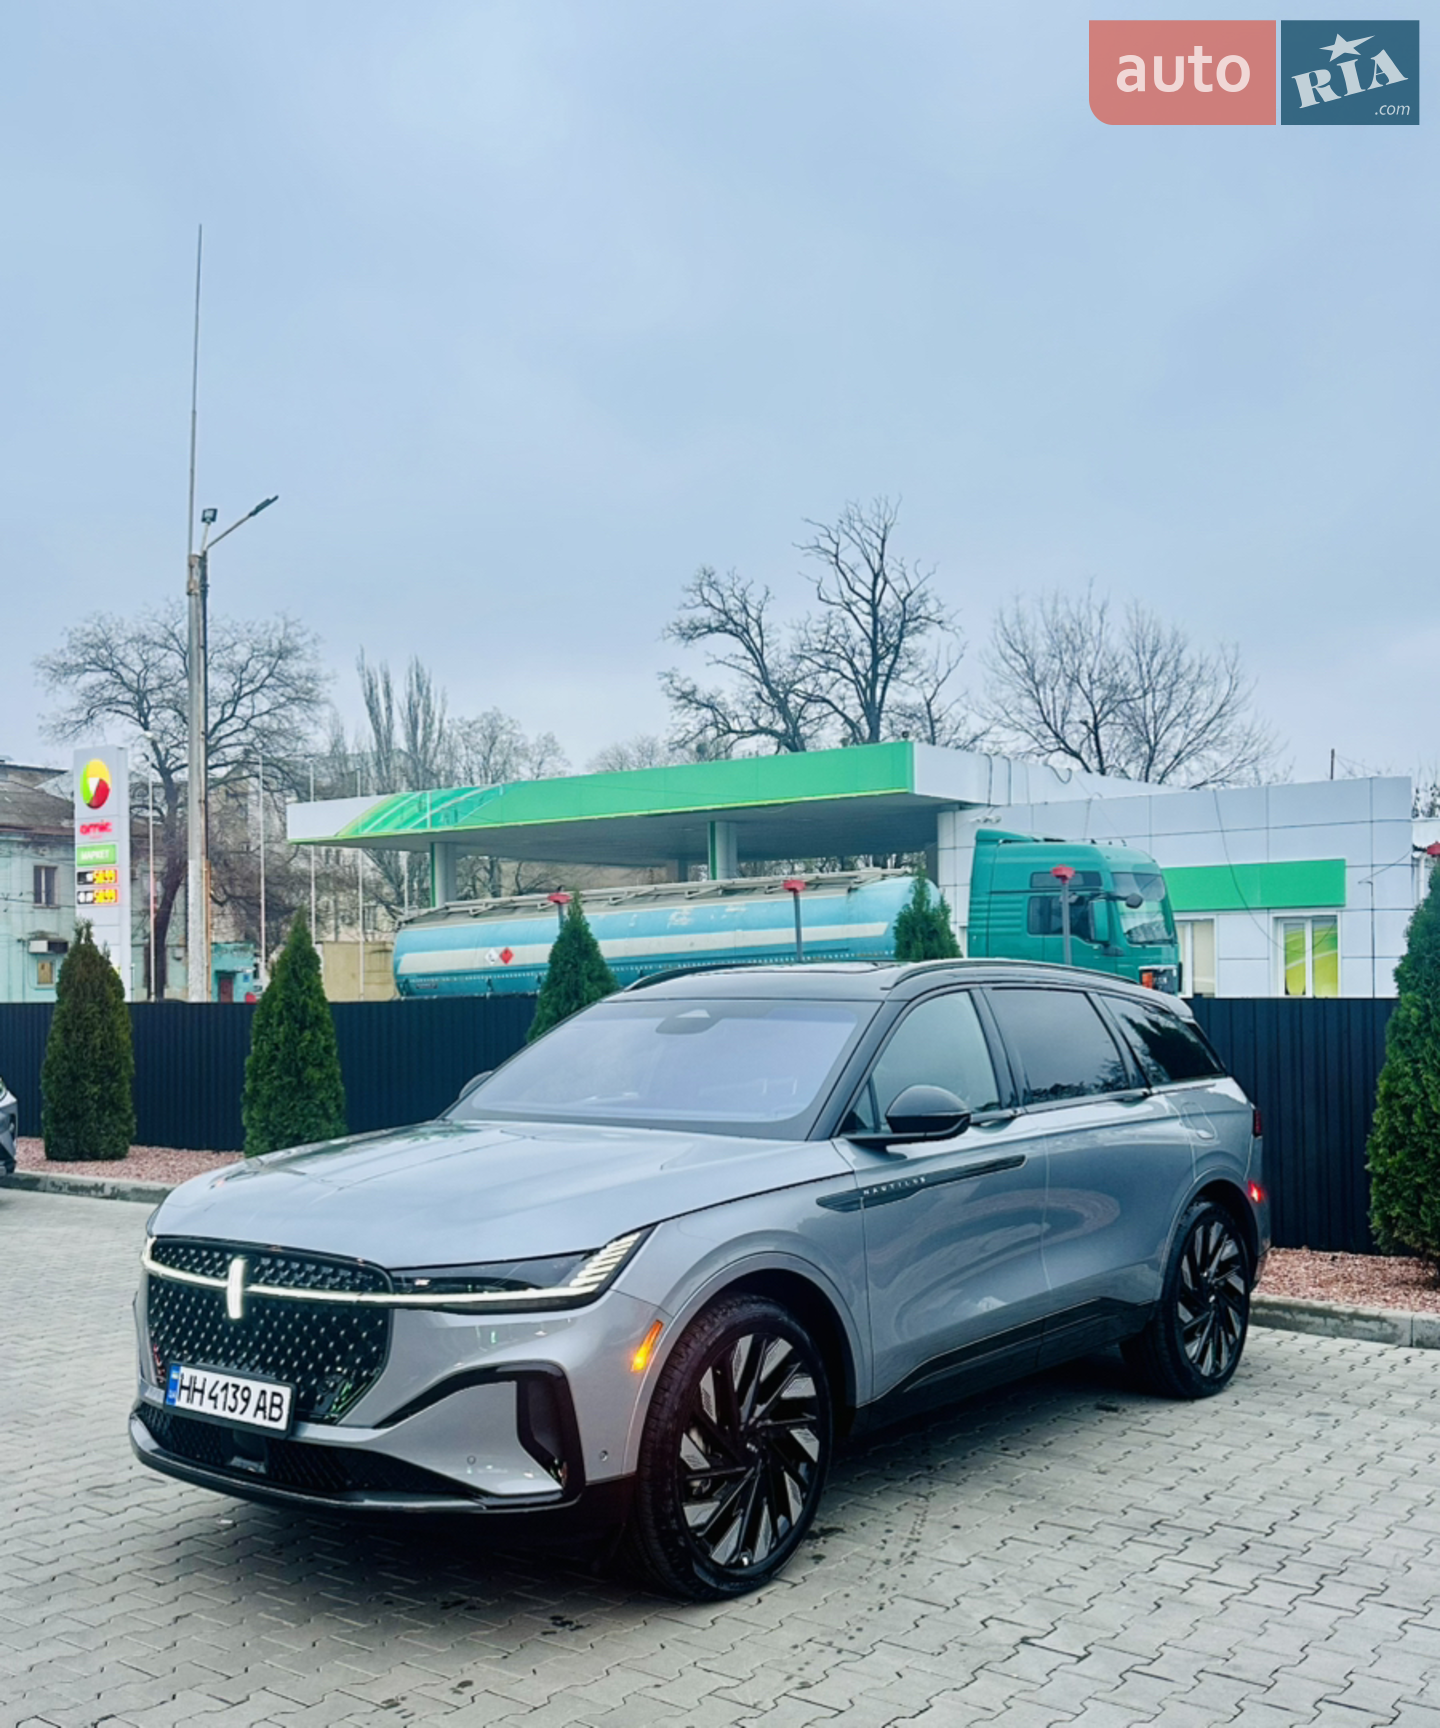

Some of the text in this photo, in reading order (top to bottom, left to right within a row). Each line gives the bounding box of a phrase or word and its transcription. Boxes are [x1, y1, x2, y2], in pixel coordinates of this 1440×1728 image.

[177, 1372, 285, 1423] HH 4139 AB
